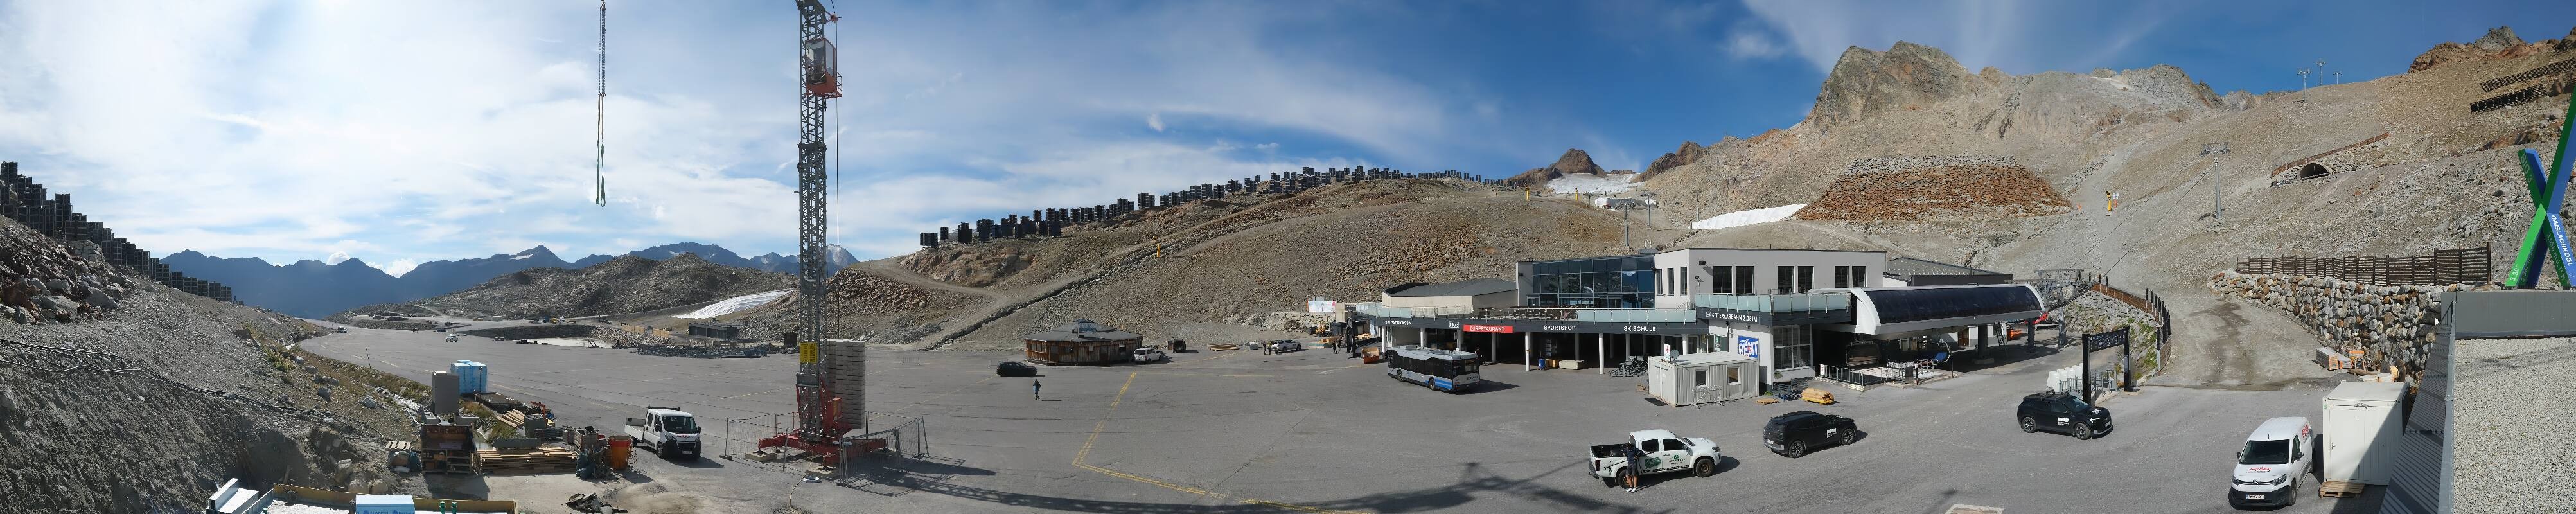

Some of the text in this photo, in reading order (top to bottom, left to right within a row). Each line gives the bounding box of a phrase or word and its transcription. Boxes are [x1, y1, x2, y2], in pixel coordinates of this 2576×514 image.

[2521, 154, 2533, 183] BIG 3
[2551, 215, 2573, 265] GAISLACHKOGL
[1711, 312, 1742, 321] SEITERKARBAHN
